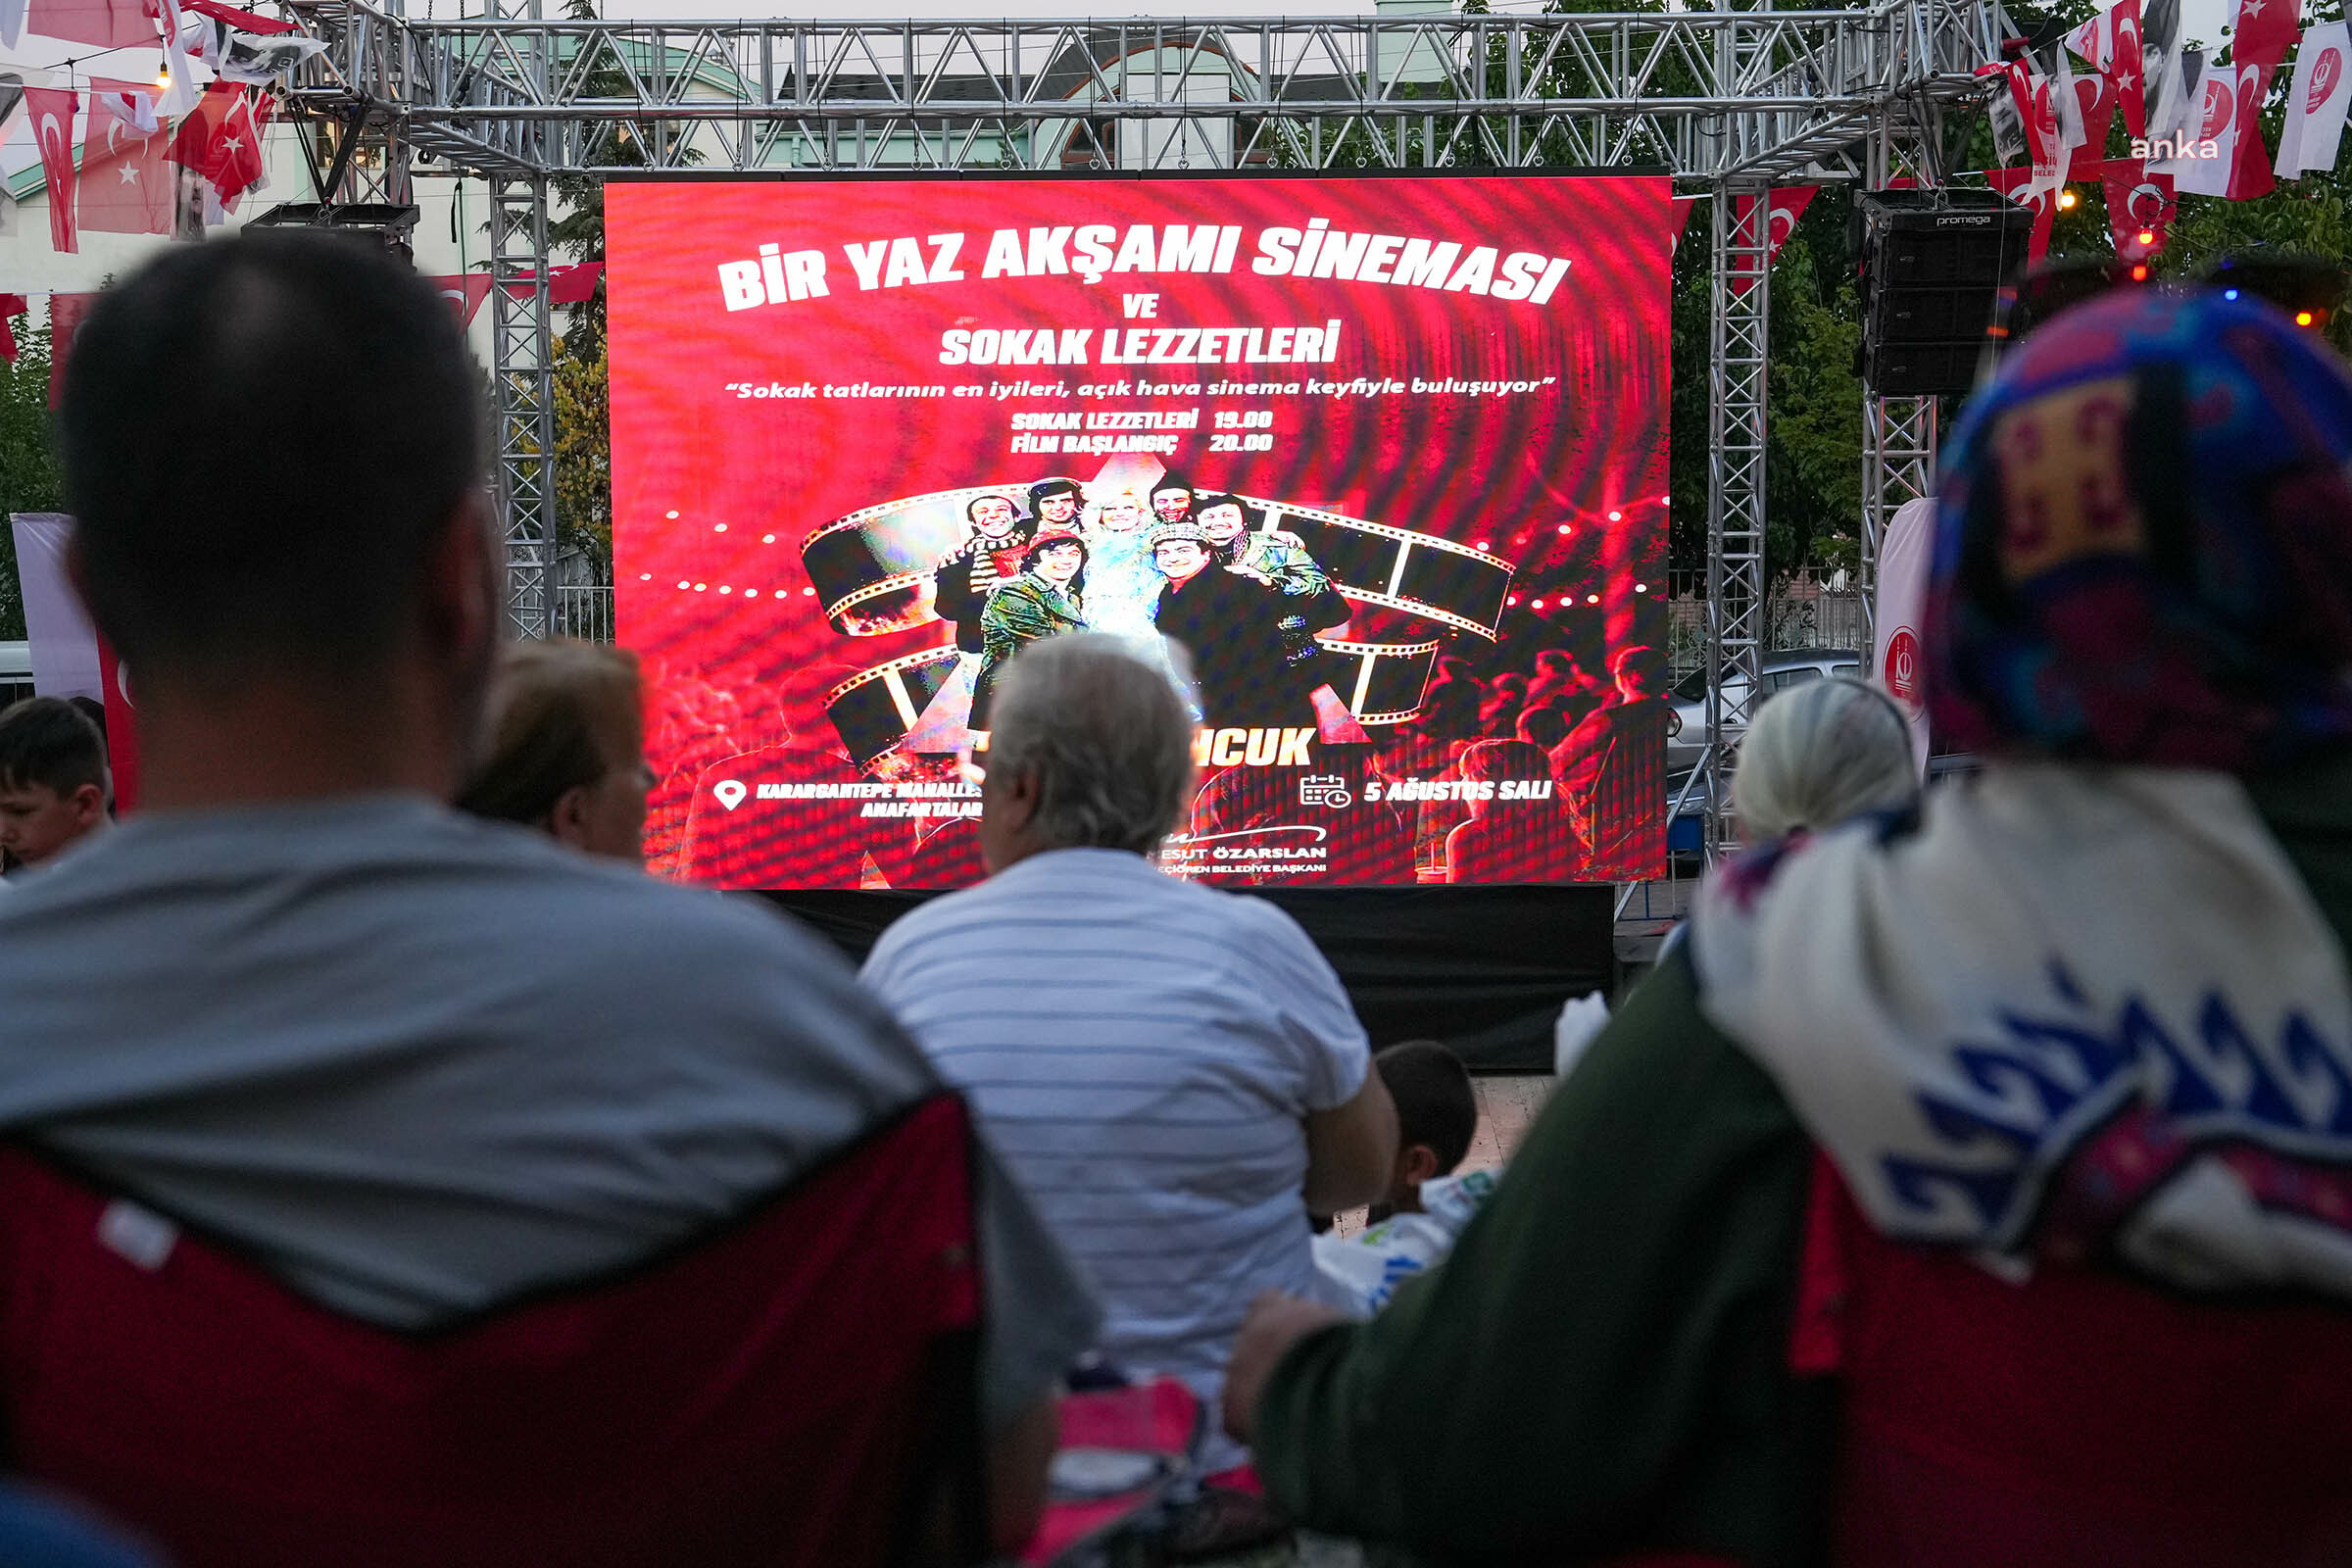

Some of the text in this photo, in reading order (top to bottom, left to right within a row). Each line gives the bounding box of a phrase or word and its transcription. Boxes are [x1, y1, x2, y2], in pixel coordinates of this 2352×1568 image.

[1936, 216, 1991, 226] promega
[717, 217, 1572, 312] BİR YAZ AKŞAMI SİNEMASI
[1122, 293, 1159, 318] VE
[939, 318, 1342, 366] SOKAK LEZZETLERİ
[822, 381, 945, 398] tatlarının
[952, 385, 983, 397] en
[988, 380, 1070, 401] iyileri,
[1077, 379, 1131, 400] açık
[1136, 379, 1201, 396] hava
[1206, 379, 1299, 395] sinema
[1305, 377, 1405, 399] keyfiyle
[1010, 408, 1273, 430] SOKAK LEZZETLERİ 19.00
[1010, 432, 1273, 456] FİLM BAŞLANGIÇ 20.00
[1363, 777, 1552, 801] 5 AĞUSTOS SALI
[1156, 847, 1327, 859] ESUT ÖZARSLAN
[1154, 864, 1327, 874] EÇİÖREN BELEDİYE BAŞKANI
